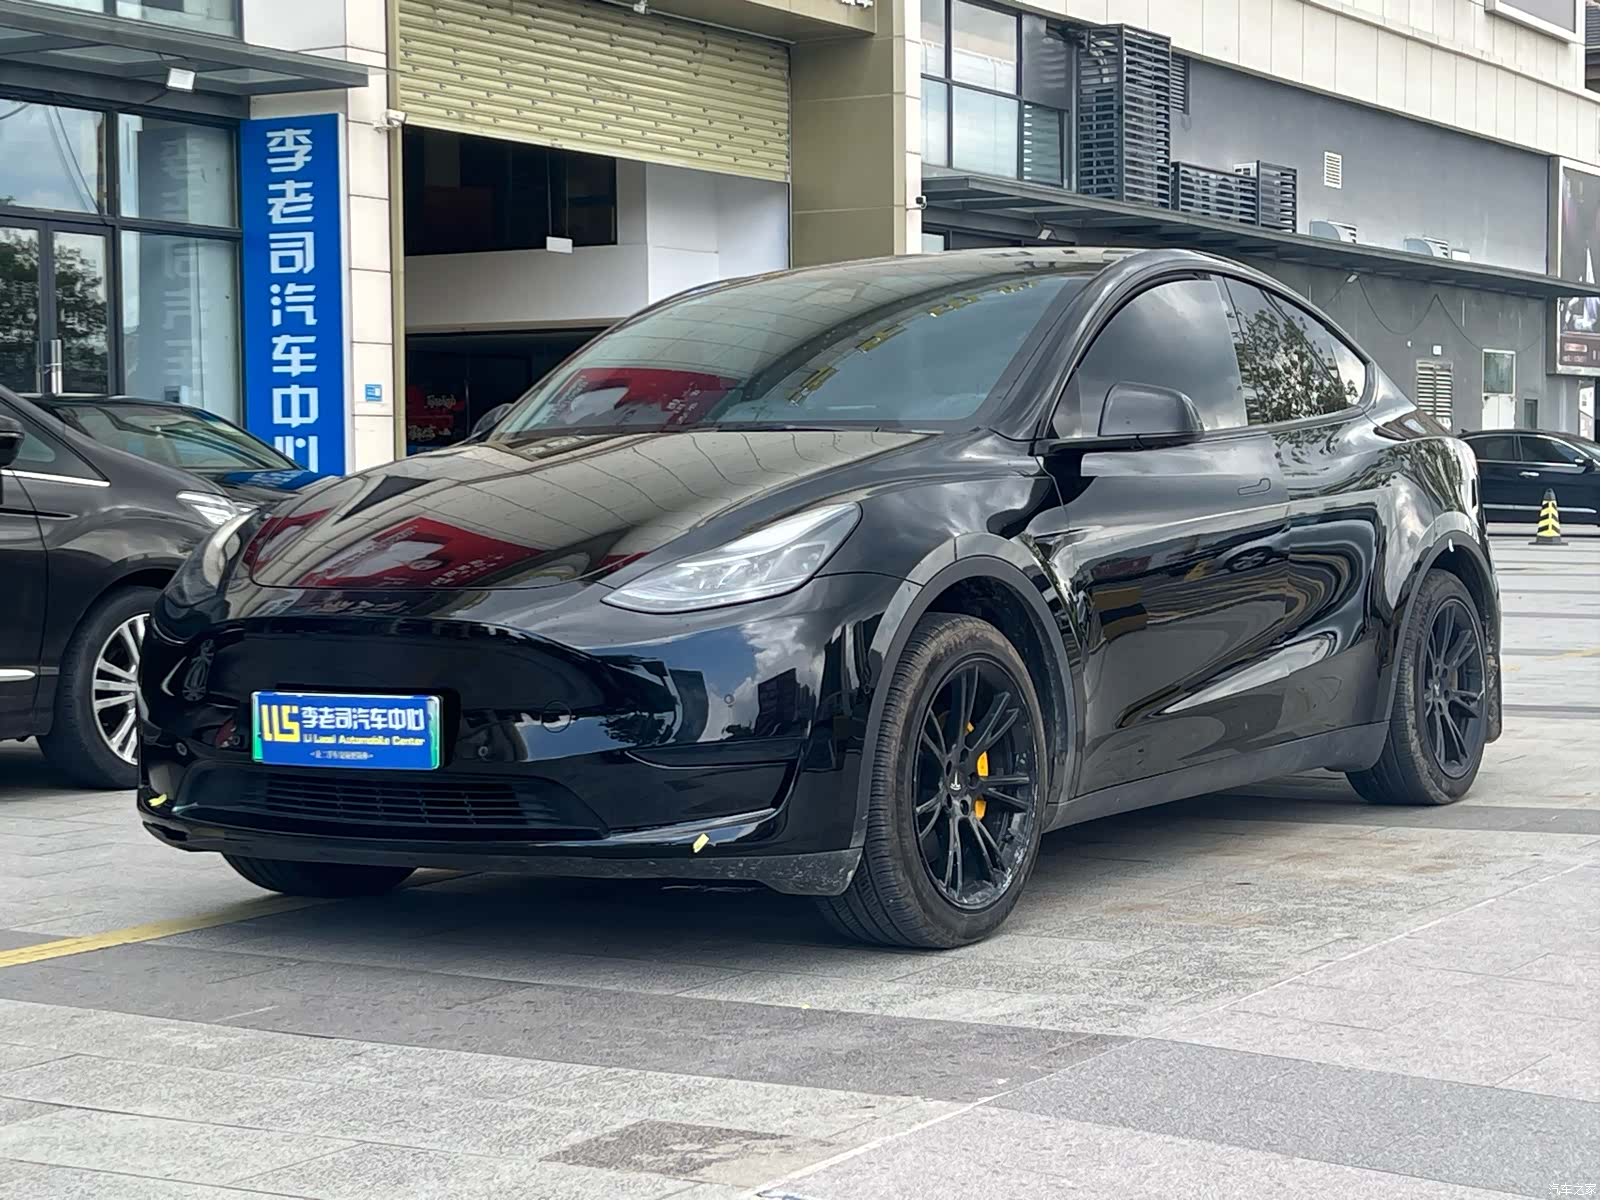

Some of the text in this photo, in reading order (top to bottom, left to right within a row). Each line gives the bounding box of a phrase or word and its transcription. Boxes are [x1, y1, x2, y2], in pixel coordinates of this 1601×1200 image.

[301, 706, 425, 731] 李老司汽车中心
